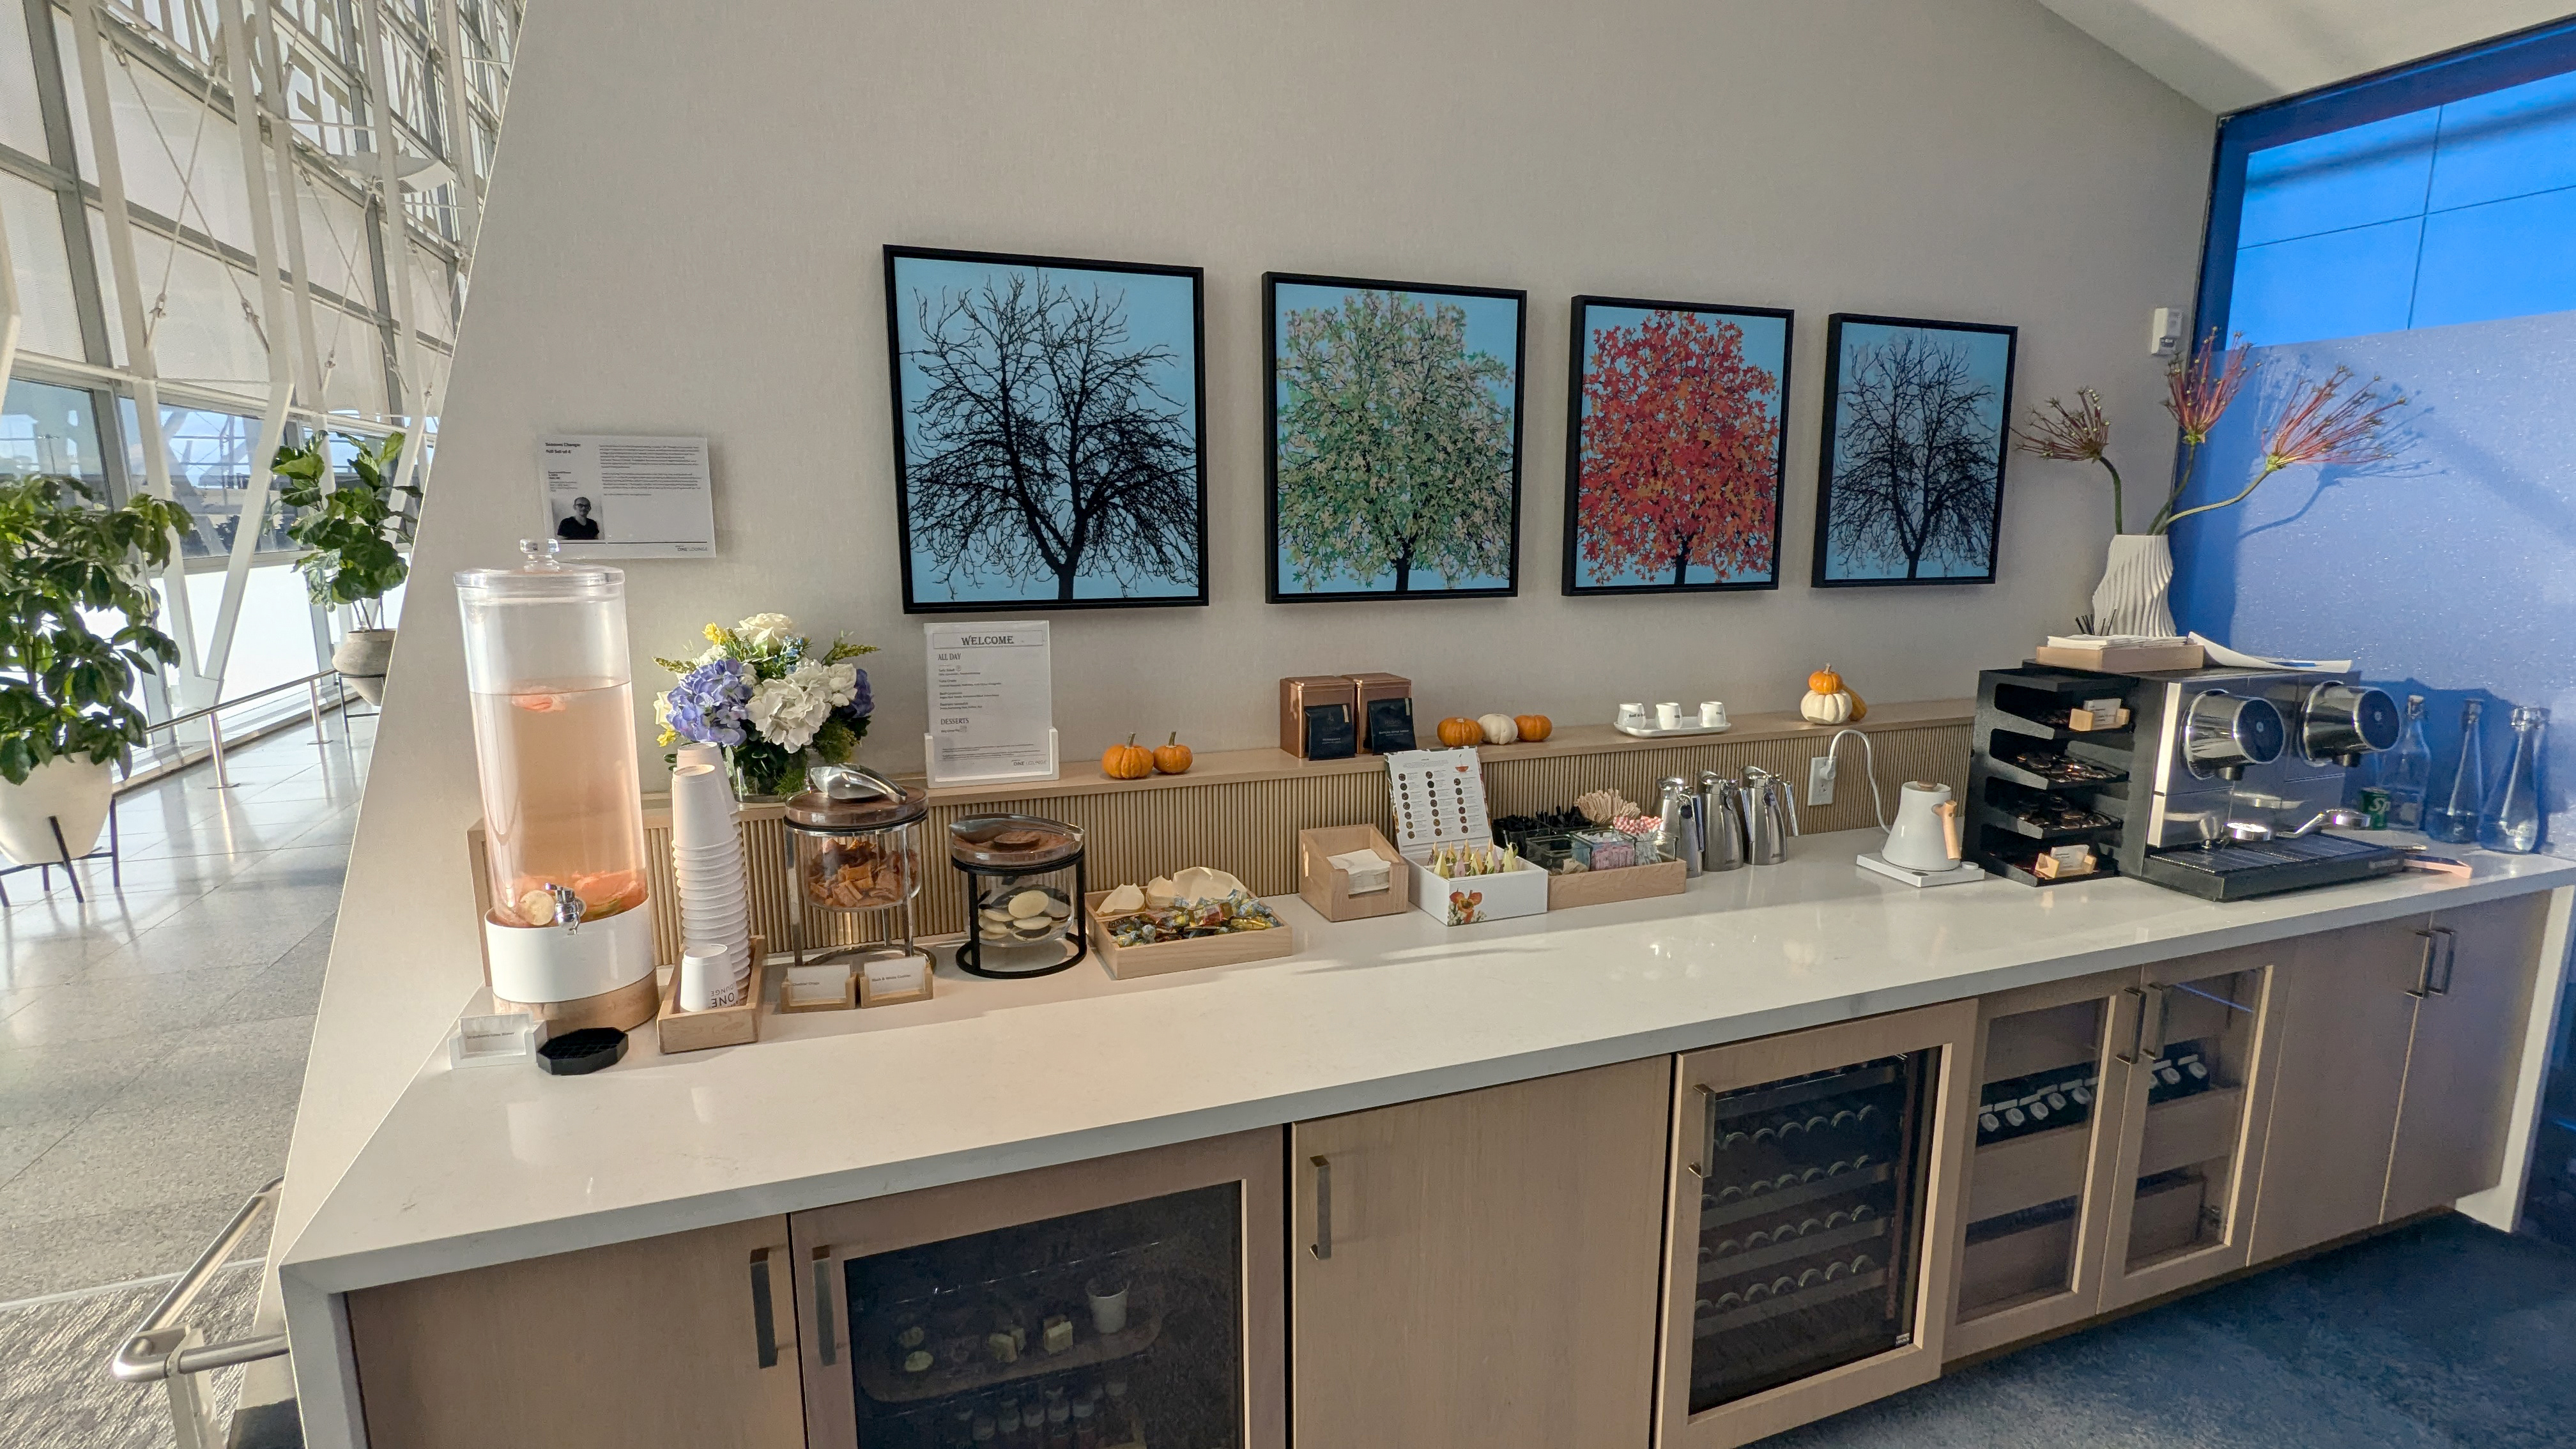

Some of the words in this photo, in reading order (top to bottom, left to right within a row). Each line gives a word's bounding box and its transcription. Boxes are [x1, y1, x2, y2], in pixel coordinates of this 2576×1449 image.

[961, 635, 1015, 645] WELCOME
[949, 652, 962, 661] DAY
[710, 992, 735, 1008] ONE
